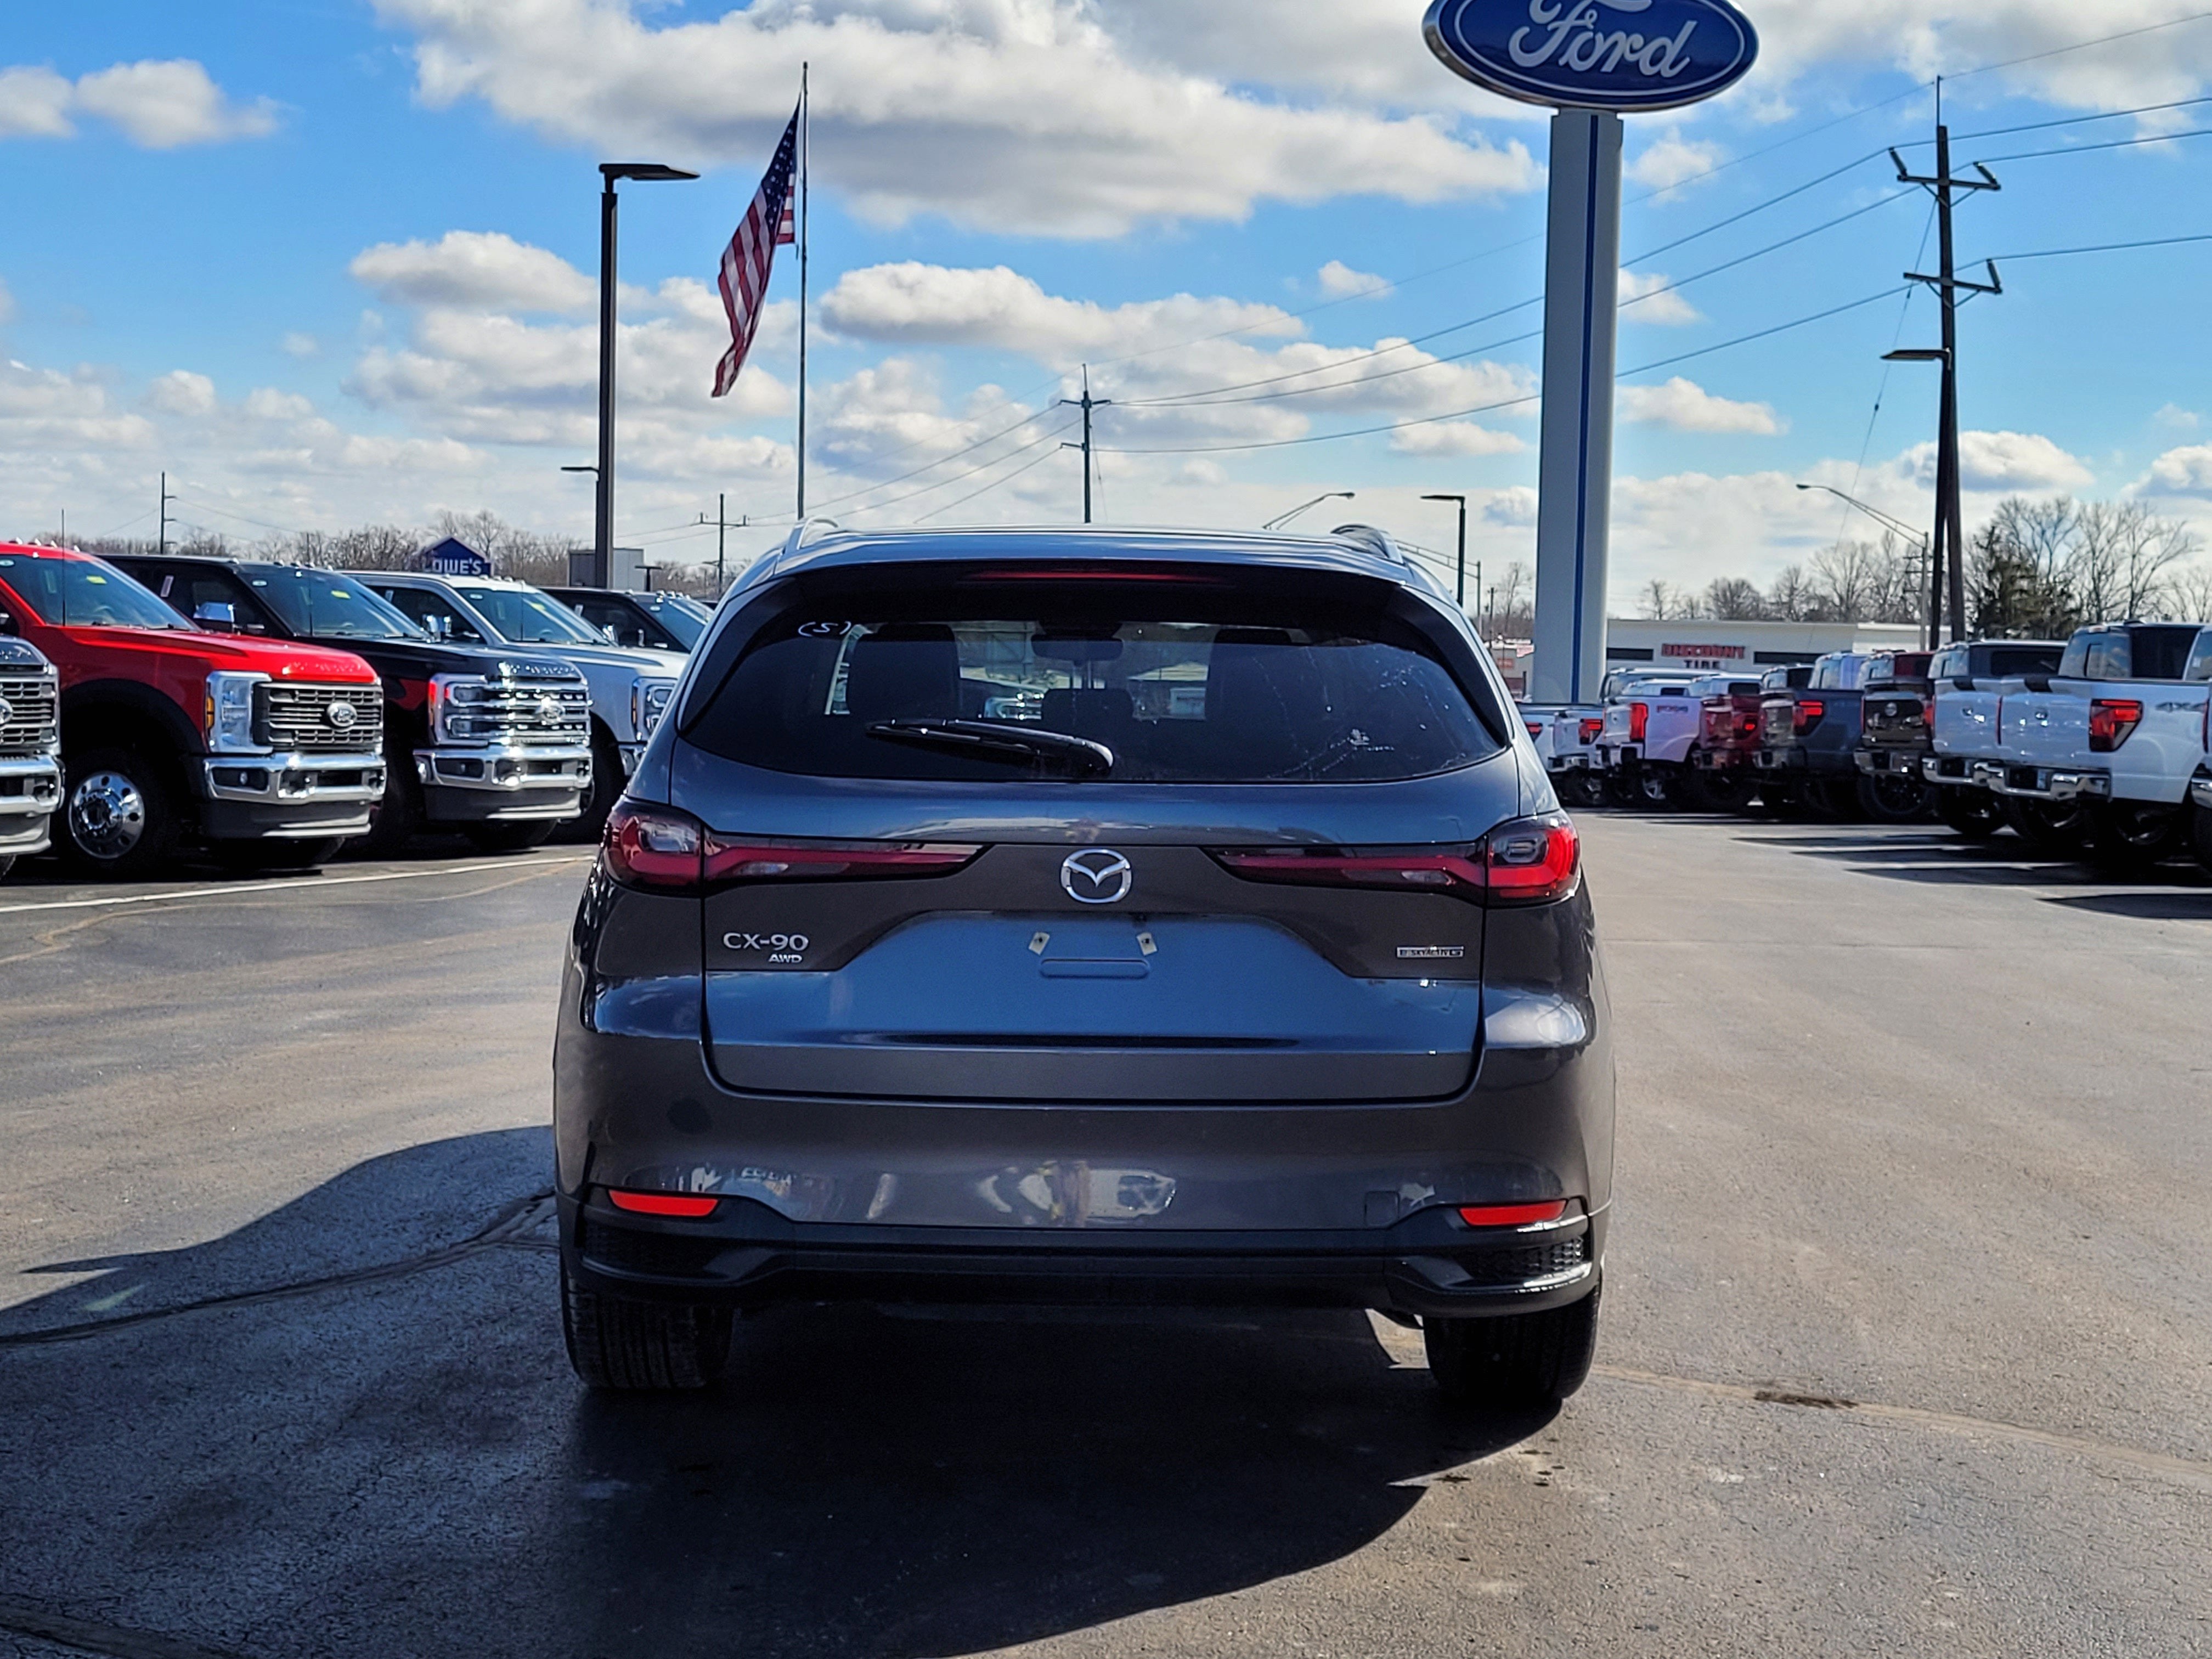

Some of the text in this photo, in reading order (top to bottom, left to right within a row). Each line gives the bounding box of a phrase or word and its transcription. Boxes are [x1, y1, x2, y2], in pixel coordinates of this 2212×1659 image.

[1509, 0, 1698, 77] Ford
[723, 932, 809, 951] CX-90
[768, 953, 803, 963] AWD
